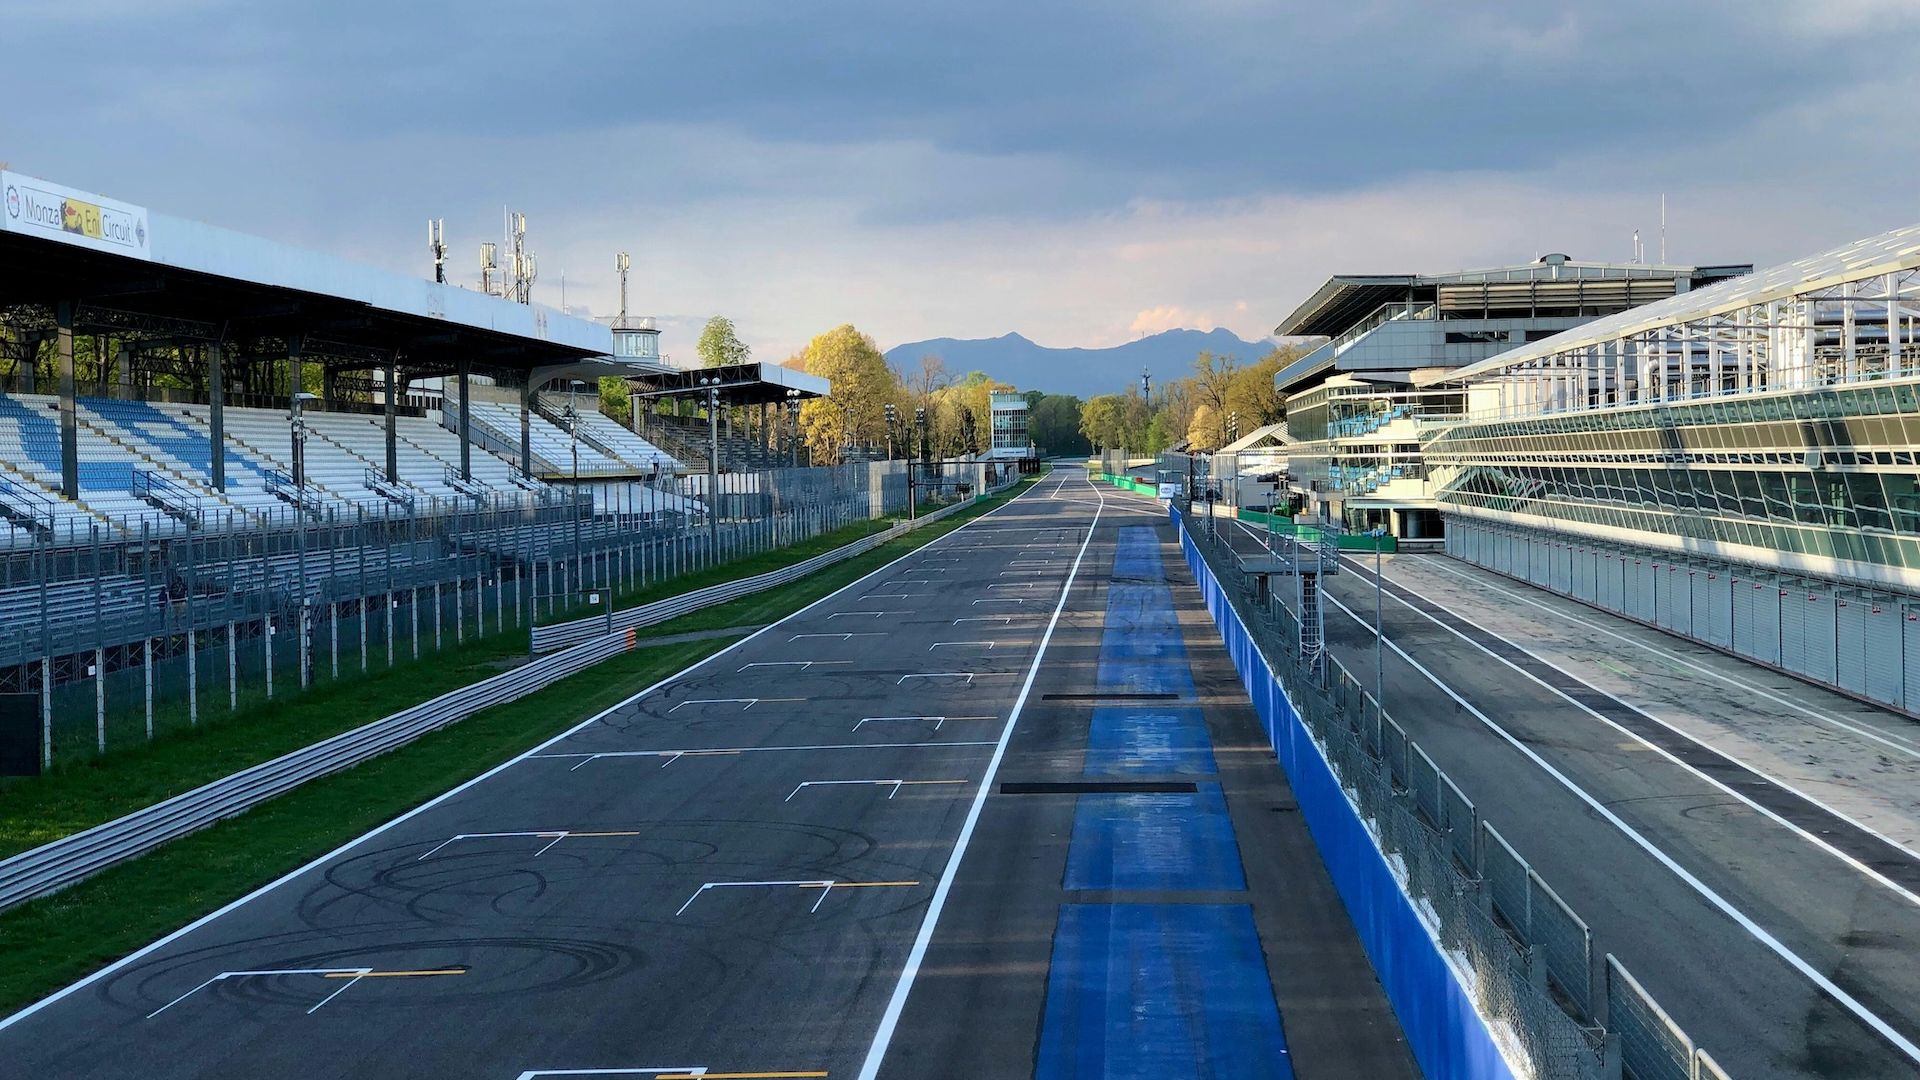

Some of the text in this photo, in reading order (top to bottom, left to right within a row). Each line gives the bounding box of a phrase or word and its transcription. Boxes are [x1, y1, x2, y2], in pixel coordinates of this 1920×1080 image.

[25, 195, 132, 242] Monza Eni Circuit
